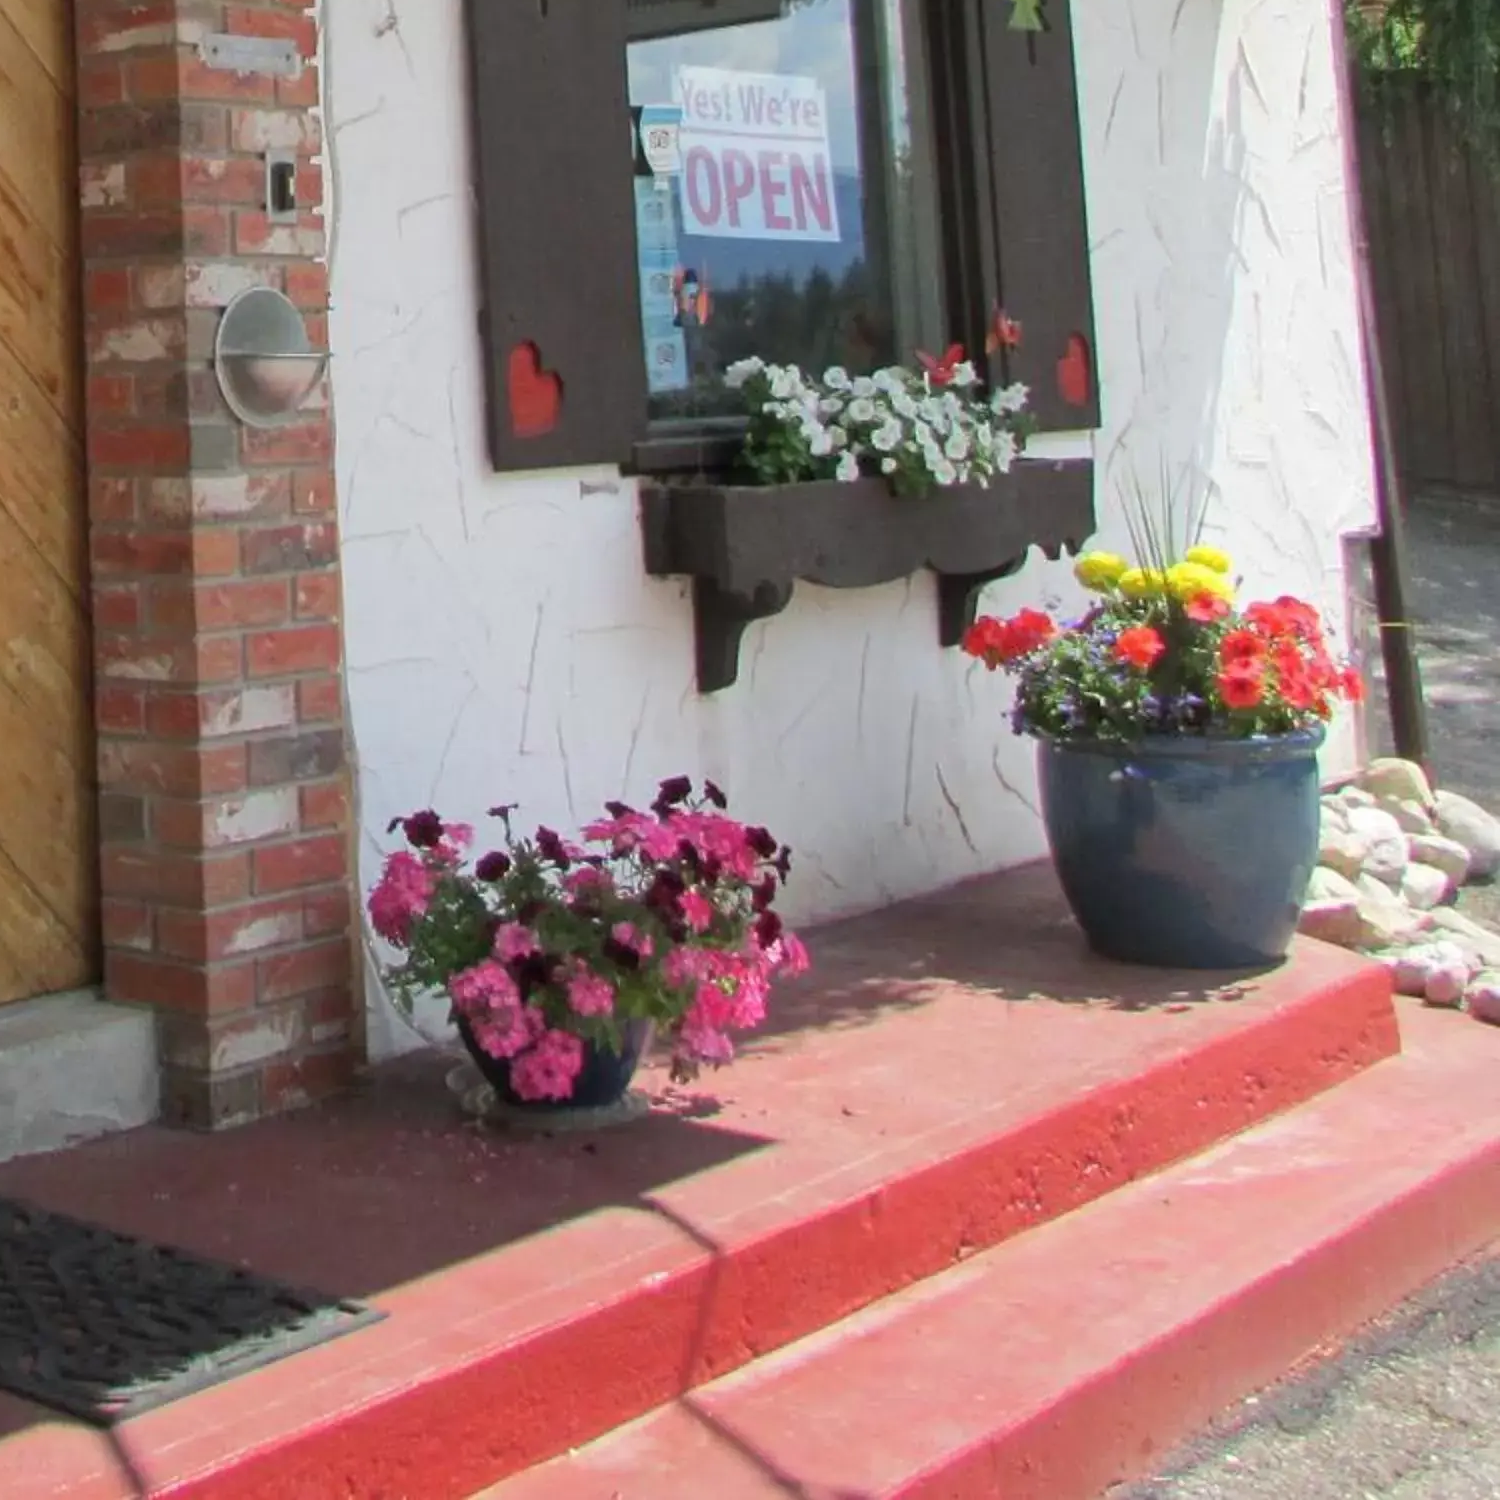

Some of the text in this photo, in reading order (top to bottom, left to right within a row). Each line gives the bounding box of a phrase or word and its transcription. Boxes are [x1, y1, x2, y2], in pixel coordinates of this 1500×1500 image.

[680, 77, 821, 128] Yes! We're
[685, 144, 833, 232] OPEN
